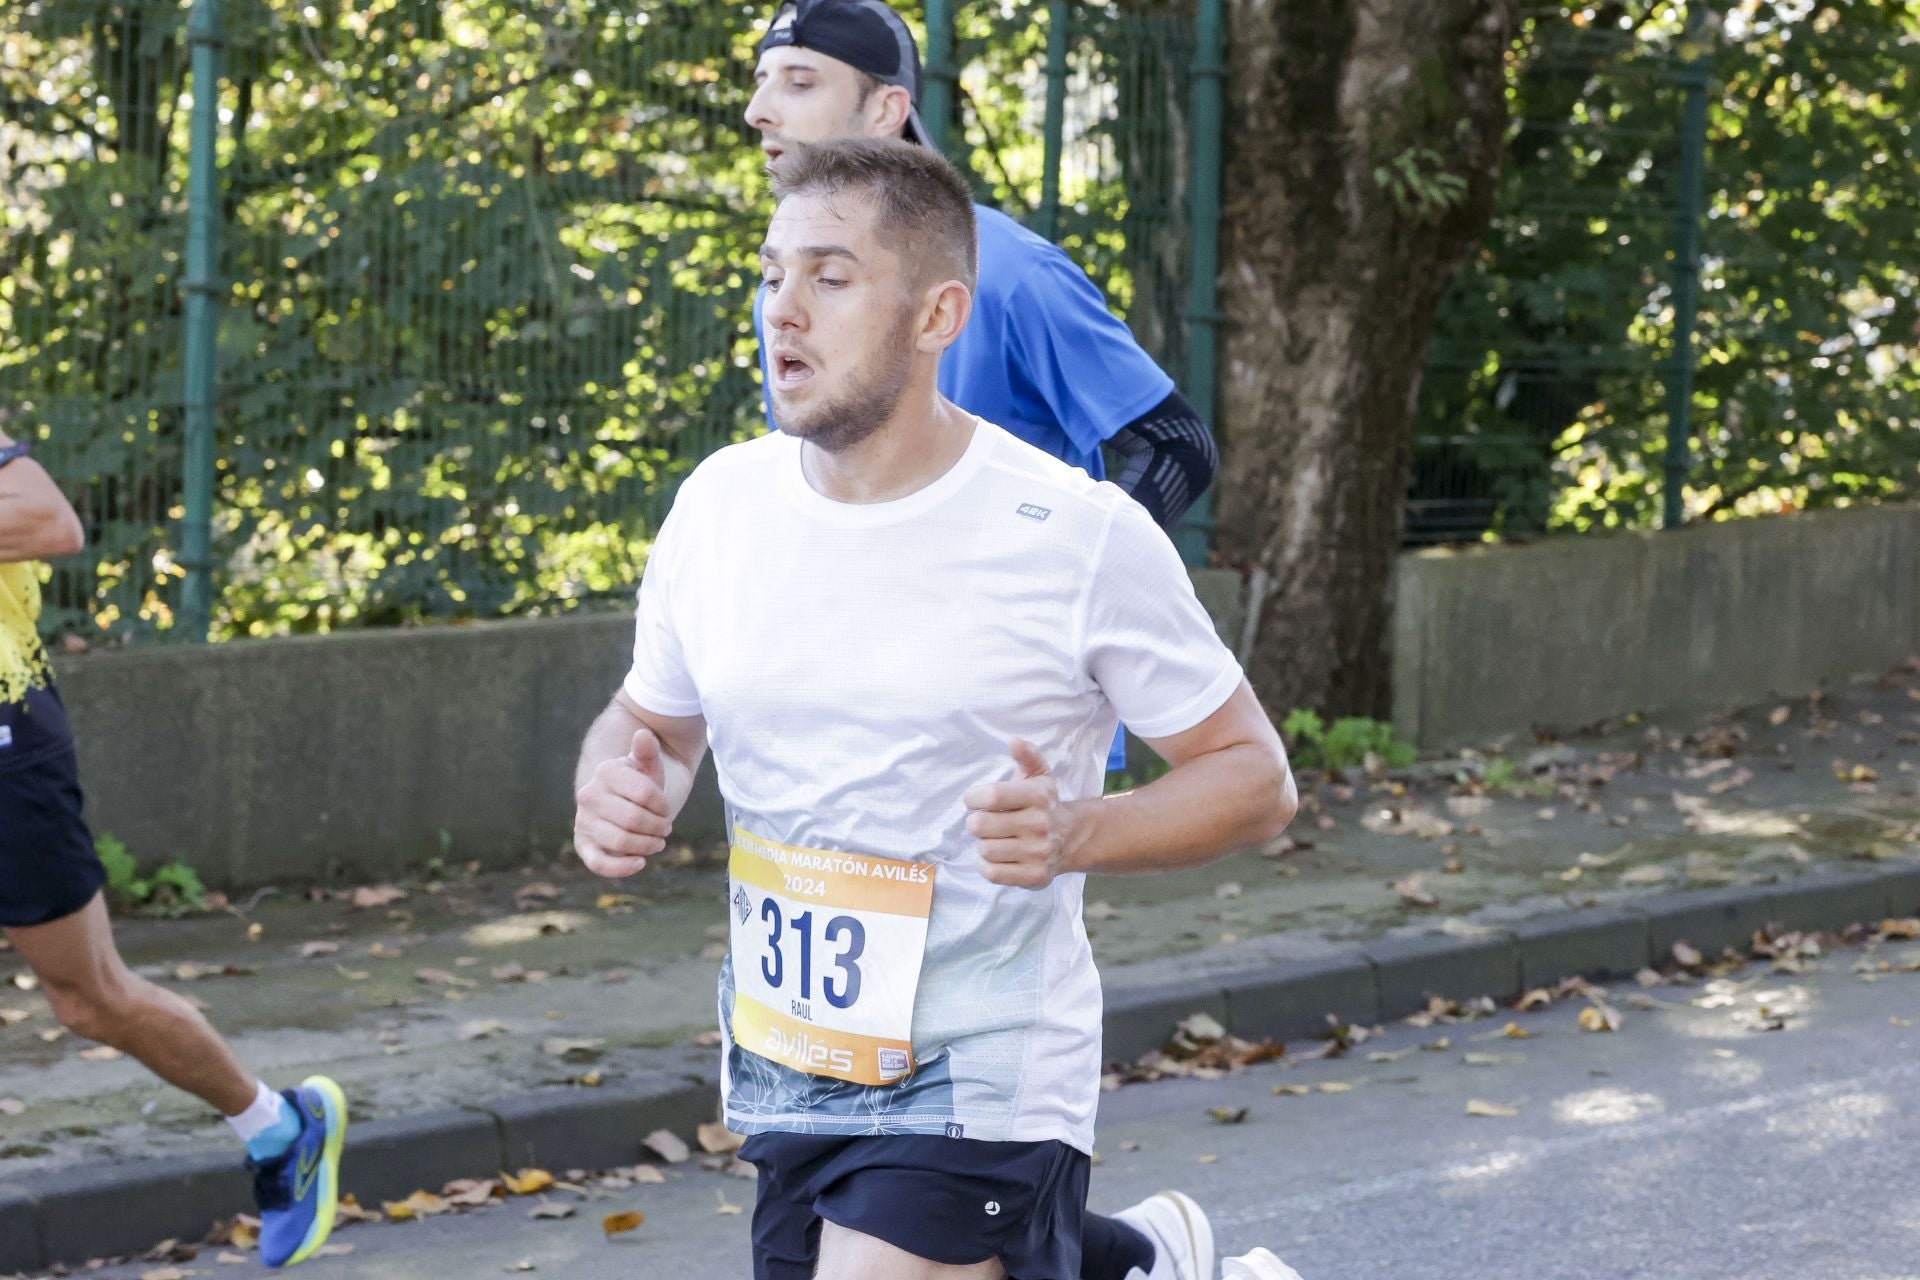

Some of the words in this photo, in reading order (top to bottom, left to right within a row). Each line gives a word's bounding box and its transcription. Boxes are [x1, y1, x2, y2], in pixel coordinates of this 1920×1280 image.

[755, 844, 787, 864] MEDIA
[791, 854, 868, 877] MARATÓN
[871, 862, 928, 884] AVILÉS
[783, 874, 826, 897] 2024
[761, 897, 866, 1009] 313
[791, 999, 813, 1021] RAUL
[764, 1027, 854, 1073] avilés
